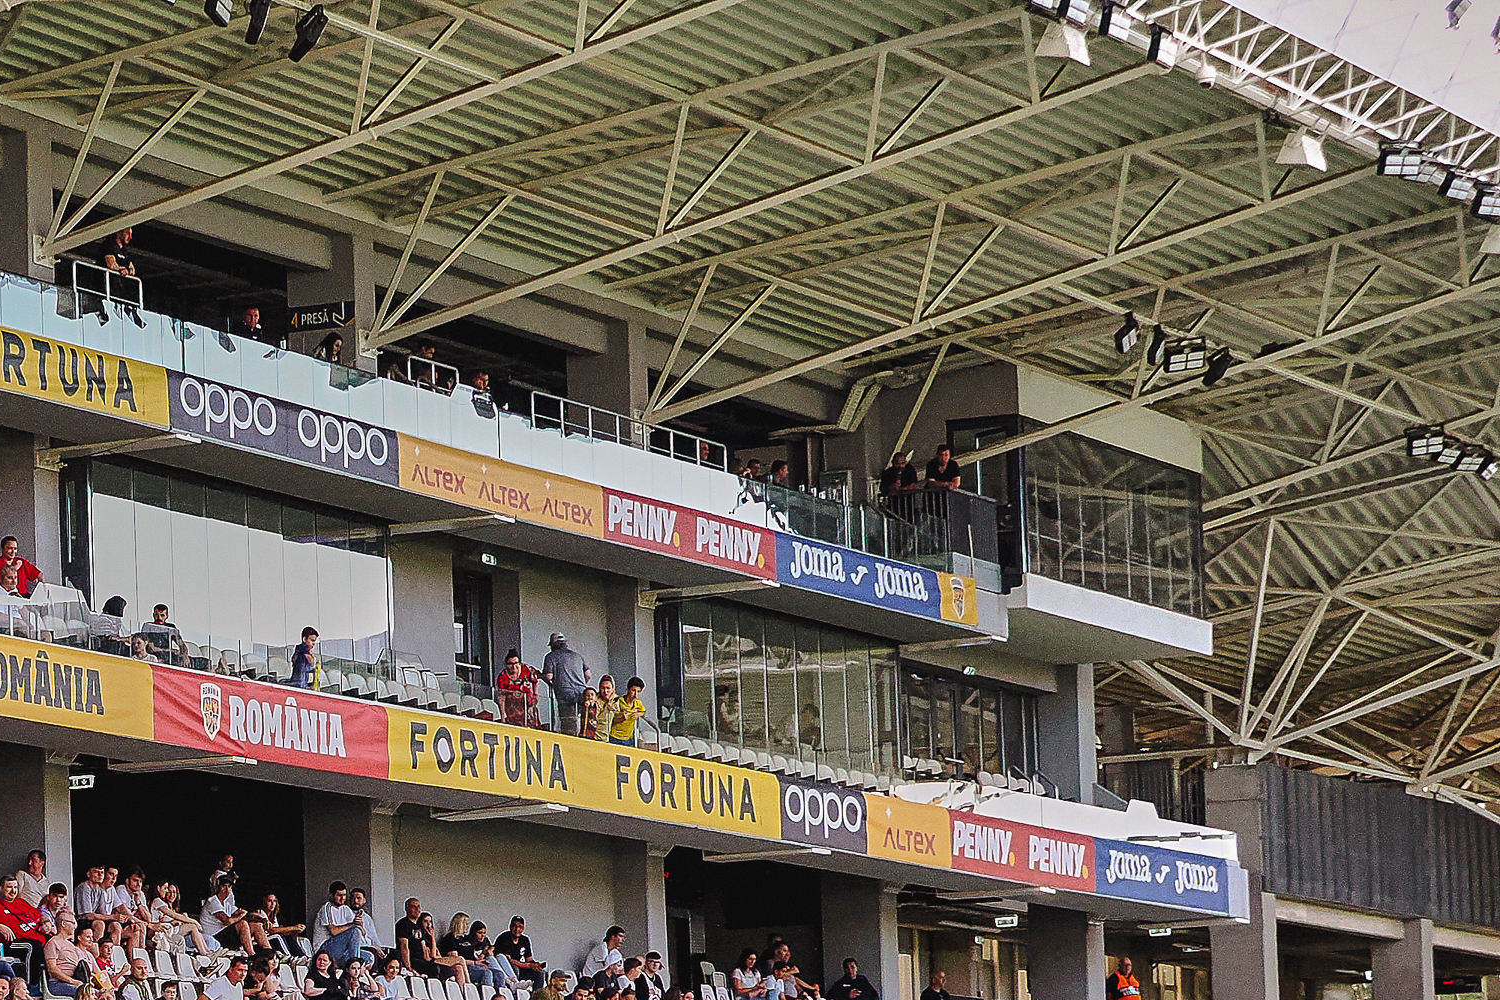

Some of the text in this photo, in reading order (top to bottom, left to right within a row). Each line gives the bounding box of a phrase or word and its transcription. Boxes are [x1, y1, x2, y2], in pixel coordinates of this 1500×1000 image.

[291, 309, 329, 328] 4 PRESĂ
[179, 376, 388, 469] oppo oppo
[229, 697, 346, 758] ROMÂNIA
[411, 723, 756, 823] FORTUNA FORTUNA
[784, 785, 863, 839] oppo
